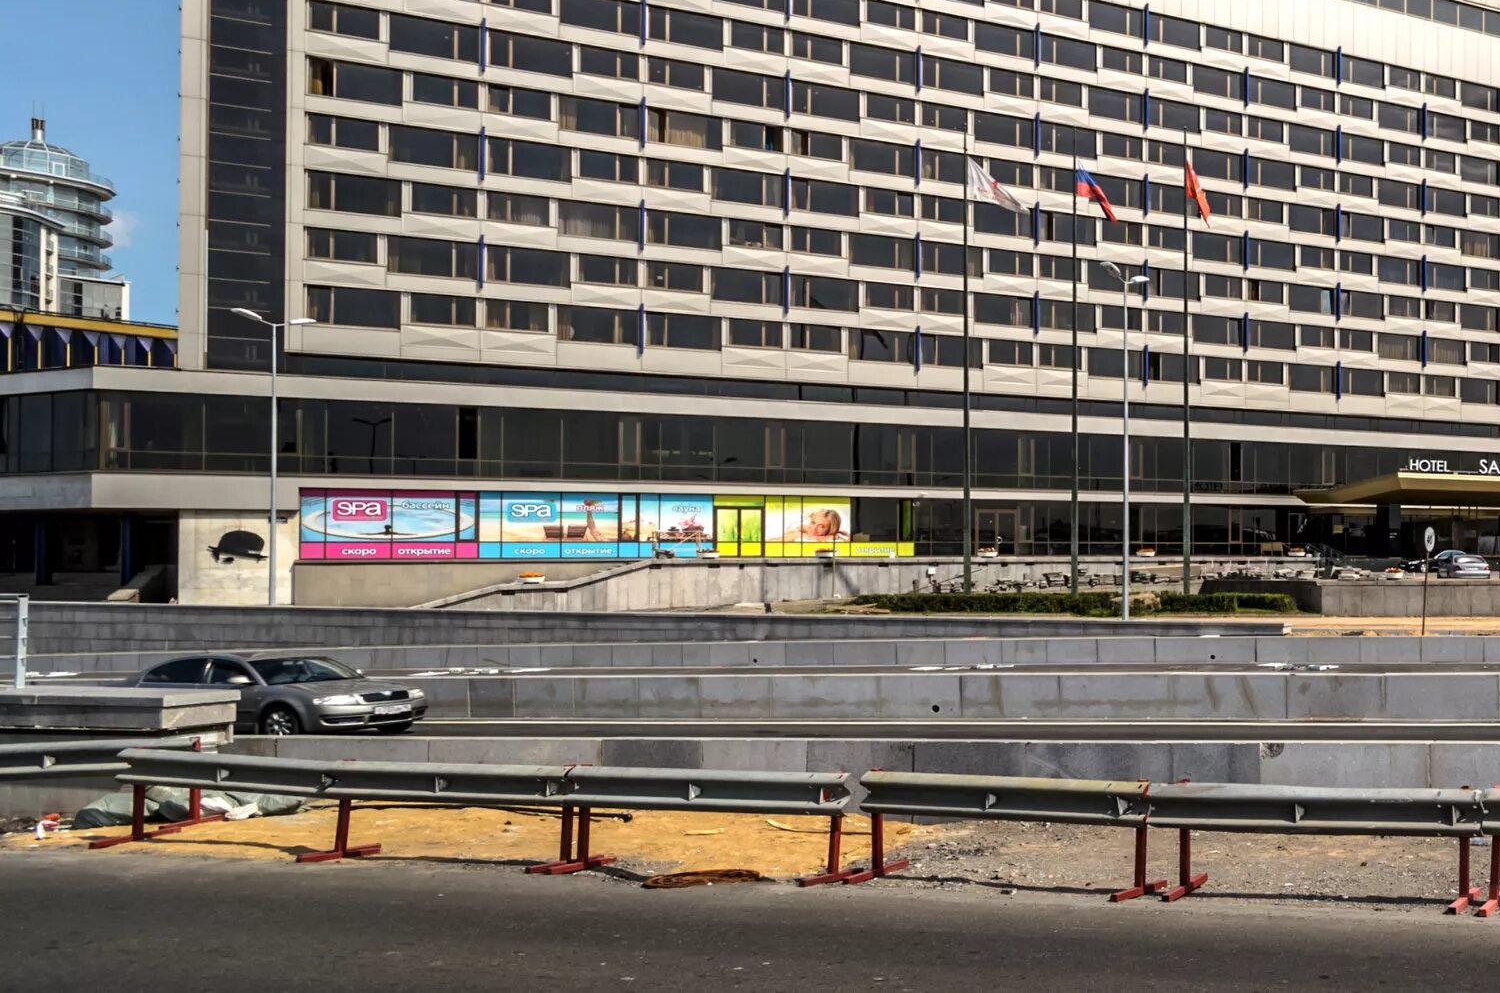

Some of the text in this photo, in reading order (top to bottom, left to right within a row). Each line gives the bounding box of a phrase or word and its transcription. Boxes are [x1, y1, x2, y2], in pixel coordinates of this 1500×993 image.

[1409, 459, 1450, 472] HOTEL
[401, 500, 450, 510] бассейн
[341, 546, 451, 557] скоро открытие
[514, 547, 613, 556] скоро открытие
